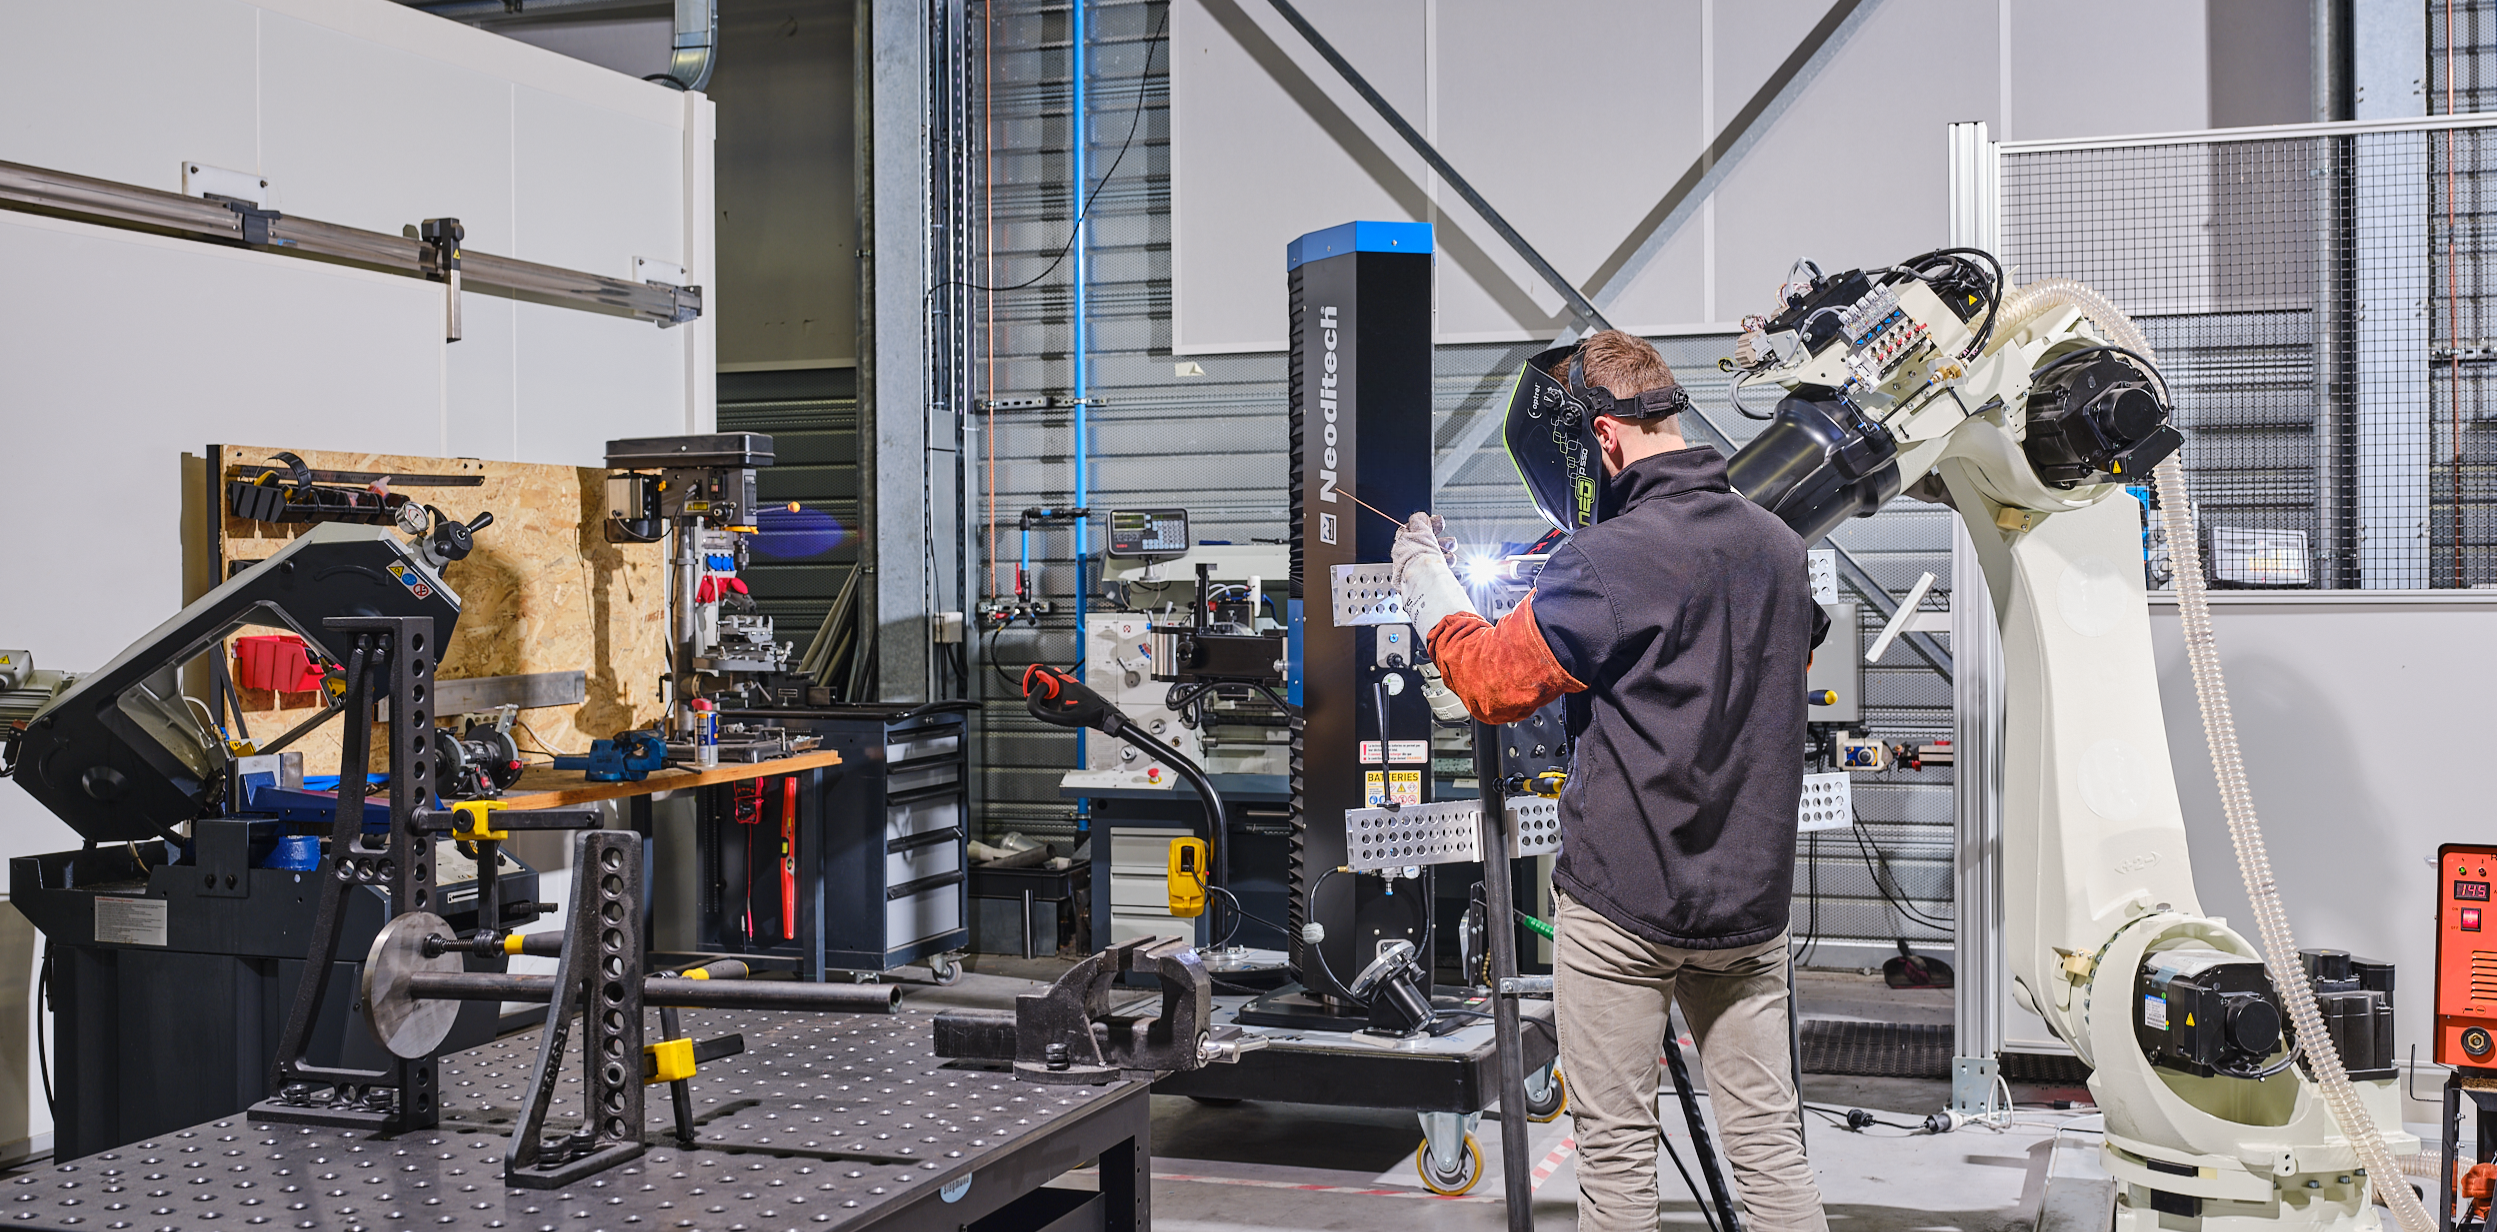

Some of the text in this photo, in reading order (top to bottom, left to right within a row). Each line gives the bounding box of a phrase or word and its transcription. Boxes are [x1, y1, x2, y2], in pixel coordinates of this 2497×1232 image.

[1532, 382, 1542, 410] optrel
[1367, 773, 1419, 782] BATERIES
[2461, 883, 2486, 898] 145
